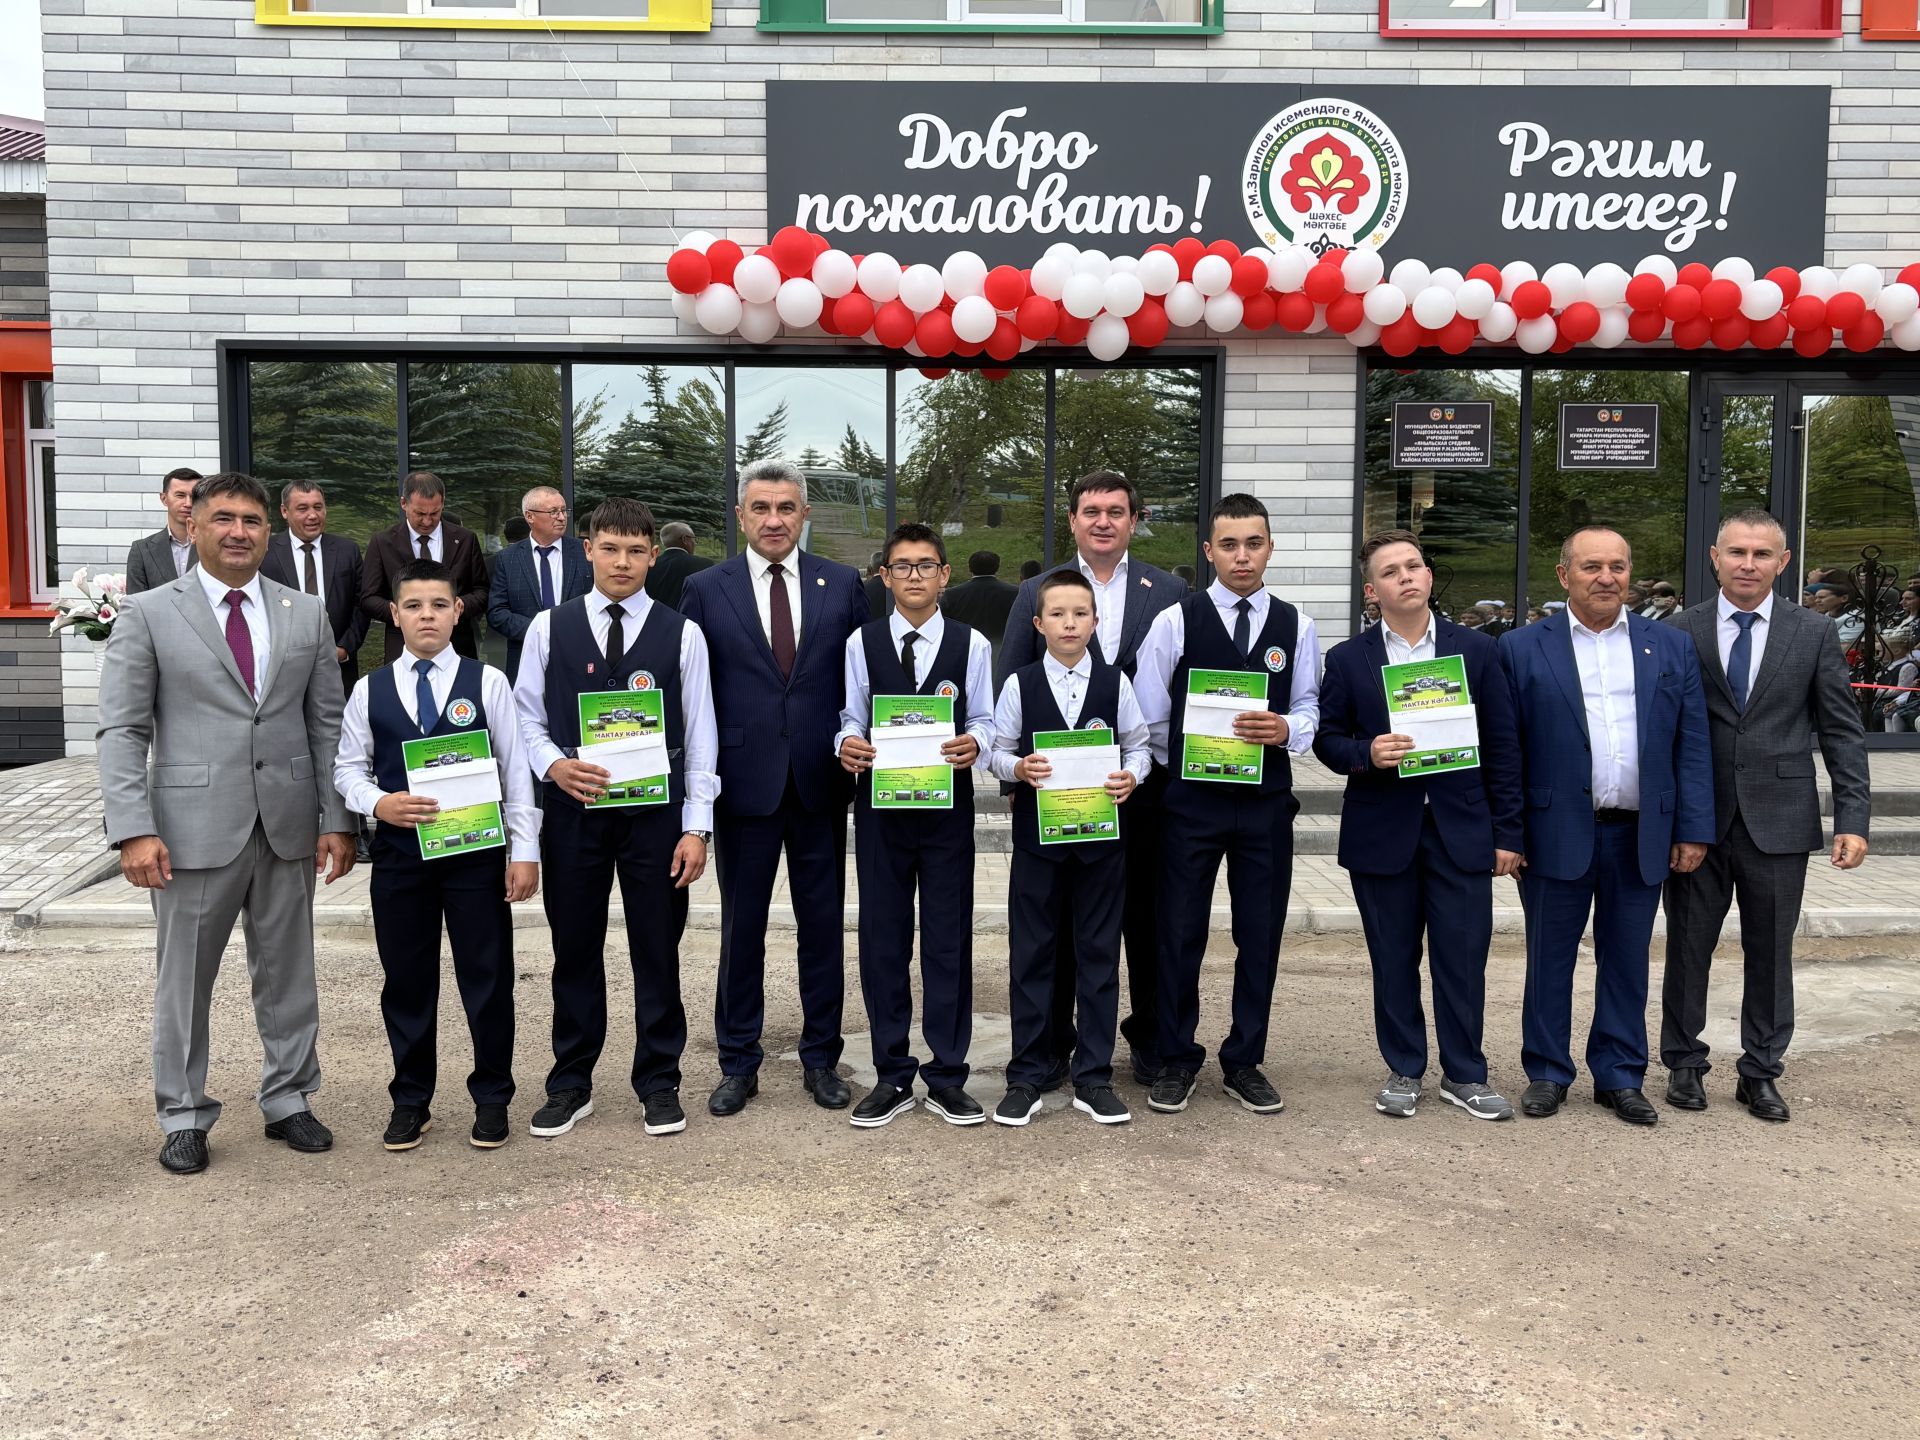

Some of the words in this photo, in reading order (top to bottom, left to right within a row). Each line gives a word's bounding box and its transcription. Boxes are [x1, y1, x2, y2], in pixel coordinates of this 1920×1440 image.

[1273, 105, 1350, 133] исемендәге
[1317, 118, 1349, 129] БАШЫ
[1352, 110, 1383, 138] Янил
[898, 106, 1098, 190] Добро
[1380, 138, 1400, 168] урта
[1498, 121, 1712, 178] Рәхим
[1246, 132, 1274, 219] Р.М.Зарипов
[796, 172, 1212, 234] пожаловать!
[1382, 172, 1402, 229] мәктәбе
[1500, 172, 1737, 252] итегез!
[1303, 221, 1347, 230] МӘКТӘБЕ
[1309, 212, 1343, 221] ШӘХЕС
[1401, 699, 1430, 709] МАКТАУ
[594, 731, 624, 739] МАКТАУ
